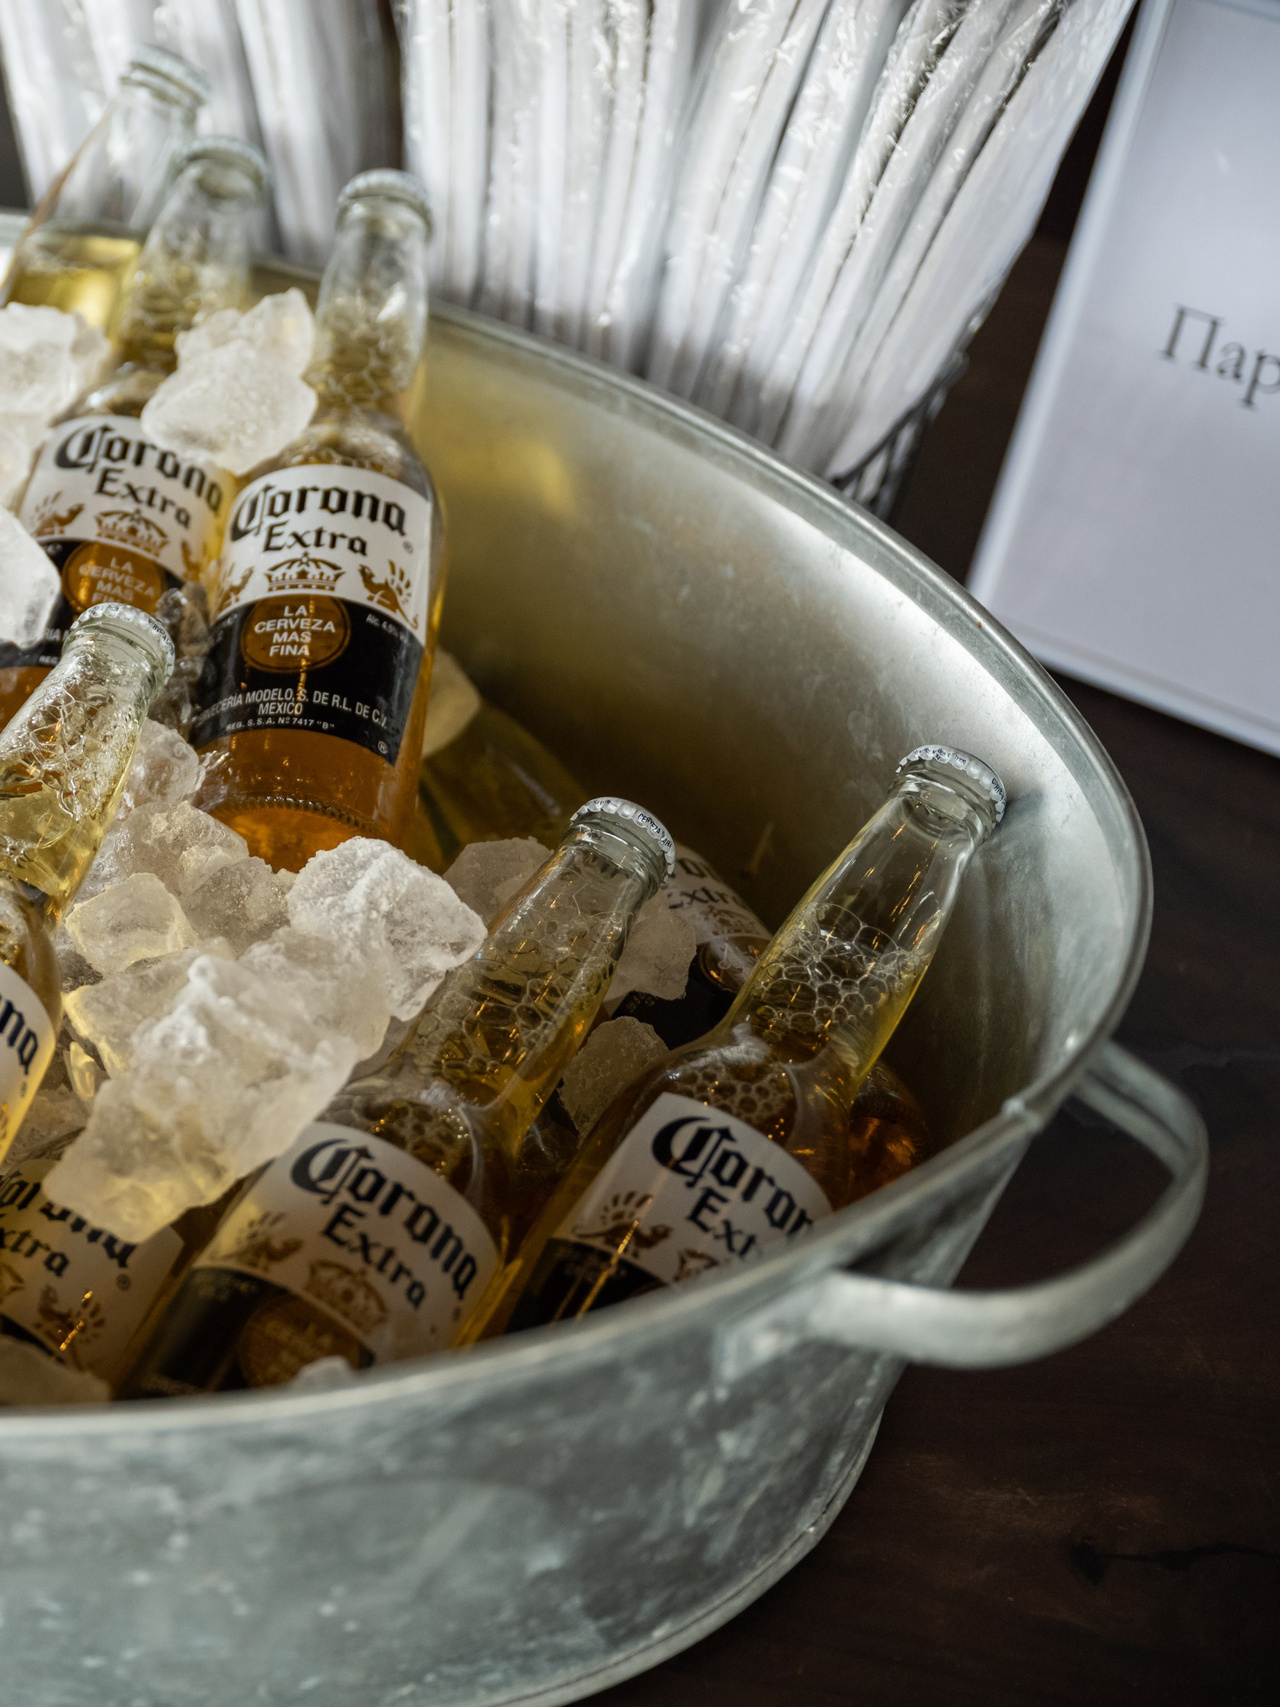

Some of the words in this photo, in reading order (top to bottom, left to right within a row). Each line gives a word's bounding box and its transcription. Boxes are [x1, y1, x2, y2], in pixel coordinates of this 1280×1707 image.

[1158, 303, 1280, 411] Пар
[54, 423, 223, 518] Corona
[95, 467, 192, 530] Extra
[230, 484, 407, 545] Corona
[263, 520, 368, 556] Extra
[78, 564, 157, 598] CERVEZA
[109, 557, 134, 574] LA
[96, 580, 134, 602] MAS
[254, 618, 336, 633] CERVEZA
[284, 605, 308, 616] LA
[270, 645, 310, 657] FINA
[272, 631, 312, 643] MAS
[245, 688, 294, 704] MODELO,
[312, 690, 329, 705] DE
[331, 694, 352, 712] R.L.
[355, 701, 370, 719] DE
[258, 702, 303, 716] MEXICO
[226, 721, 245, 732] REG.
[292, 717, 314, 727] 7417
[290, 1138, 478, 1300] Corona
[322, 1203, 426, 1310] Extra
